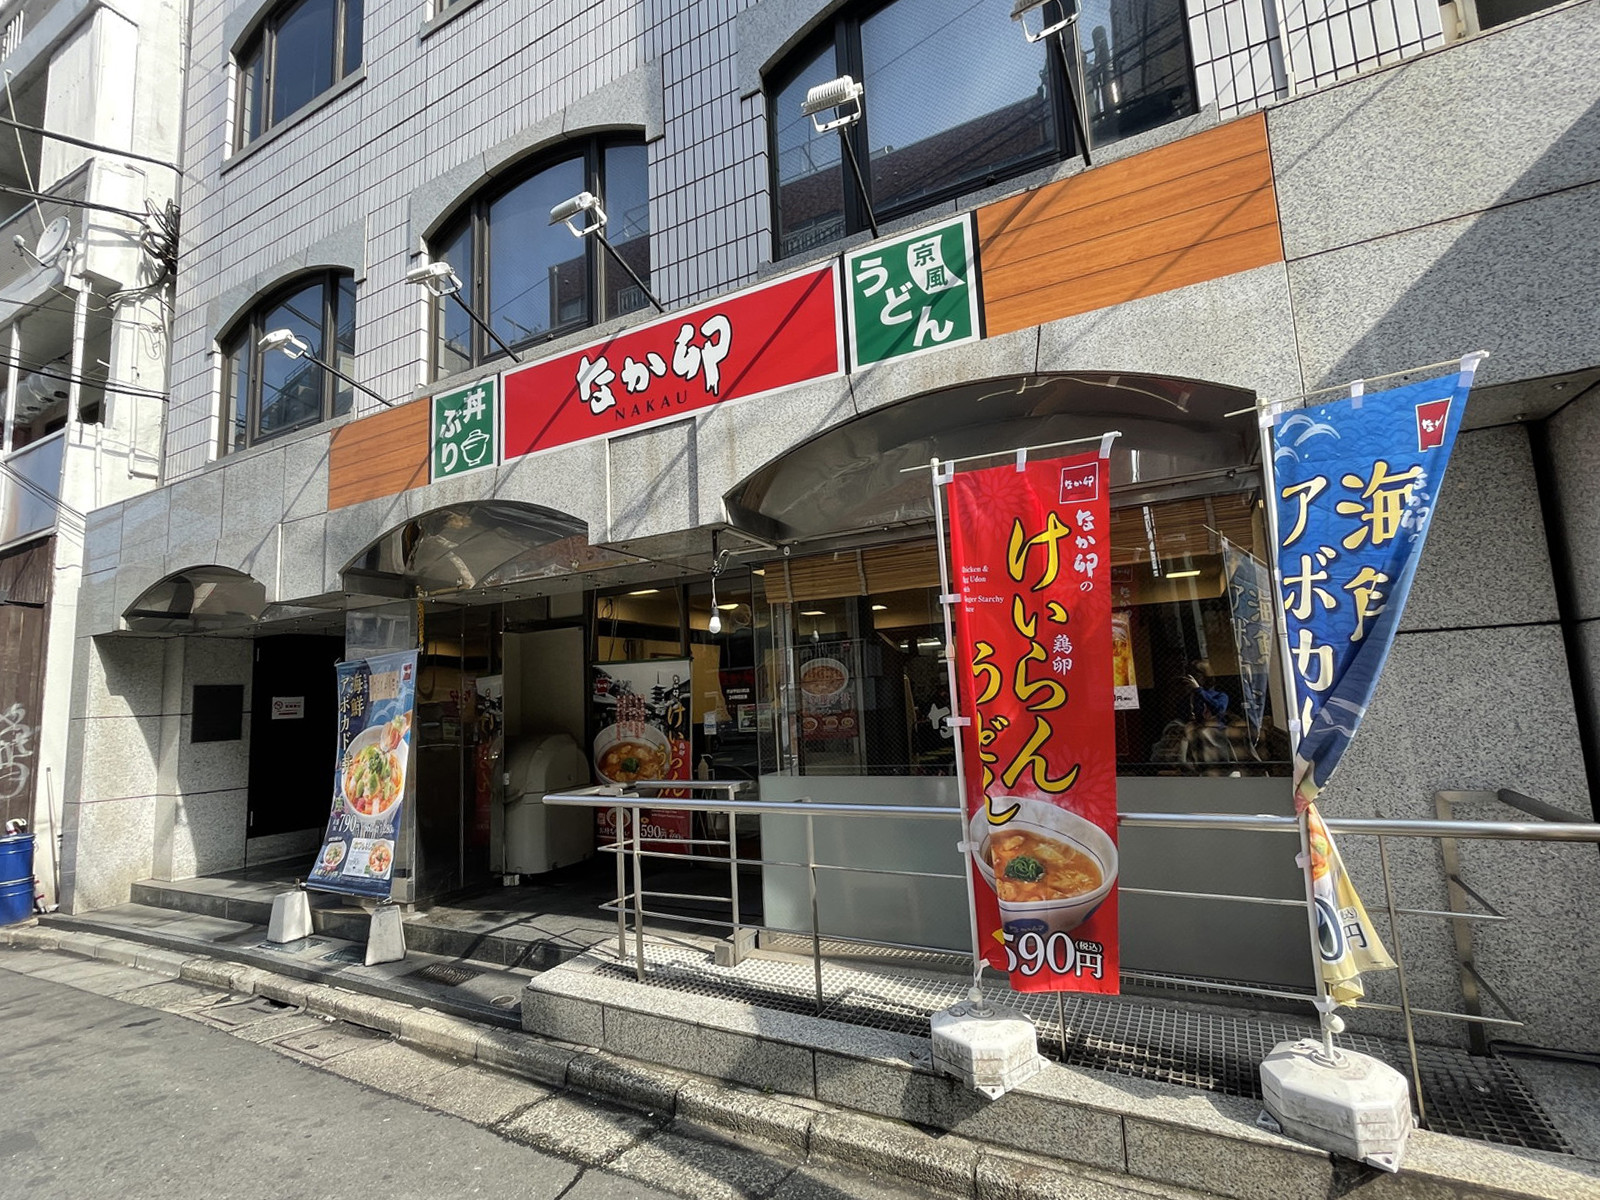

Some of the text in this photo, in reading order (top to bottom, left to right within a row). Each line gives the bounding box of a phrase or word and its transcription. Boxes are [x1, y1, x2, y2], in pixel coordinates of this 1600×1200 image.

[912, 243, 948, 291] 京風
[856, 256, 954, 347] うどん
[576, 314, 732, 416] なか卯
[615, 390, 688, 421] NAKAU
[1064, 475, 1094, 490] なか卯
[1074, 509, 1098, 592] なか卯の
[978, 594, 1004, 604] Starchy
[1002, 511, 1081, 794] けいらん
[1052, 634, 1073, 676] 鶏卵
